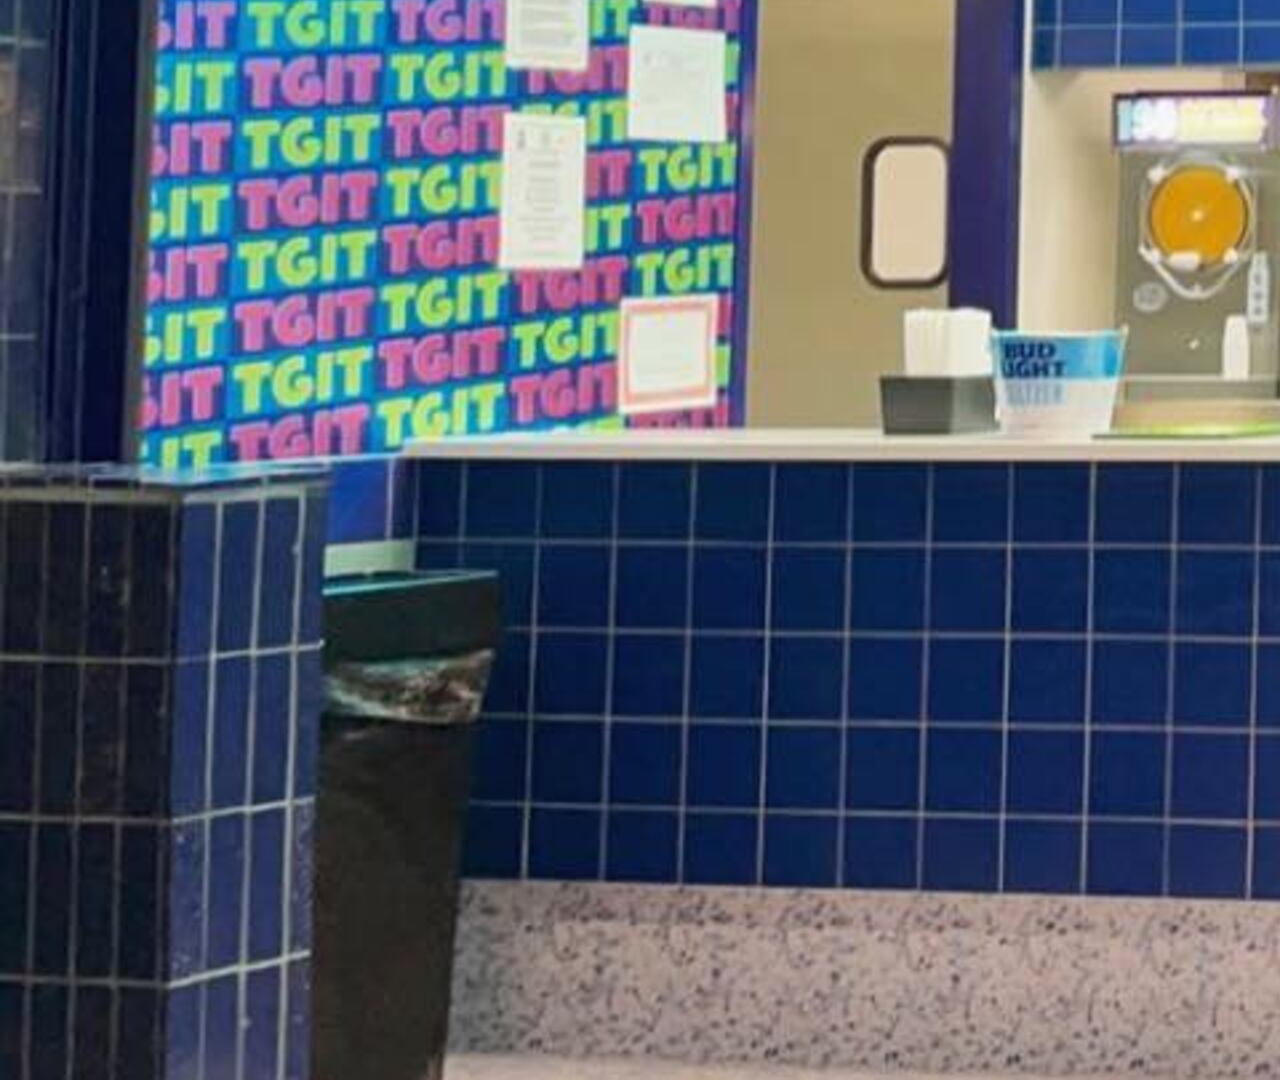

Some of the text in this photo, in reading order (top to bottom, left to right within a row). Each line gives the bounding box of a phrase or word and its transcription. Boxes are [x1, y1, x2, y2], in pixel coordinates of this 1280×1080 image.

[244, 54, 382, 108] TGIT
[242, 114, 381, 168] TGIT
[238, 170, 378, 230] TGIT
[639, 144, 736, 192] TGIT
[237, 229, 377, 291] TGIT
[637, 193, 736, 244] TGIT
[234, 287, 374, 352] TGIT
[380, 271, 508, 331] TGIT
[514, 255, 628, 313] TGIT
[635, 243, 734, 297] TGIT
[232, 346, 374, 414] TGIT
[378, 326, 505, 389] TGIT
[1003, 341, 1057, 360] BUD
[230, 403, 370, 462] TGIT
